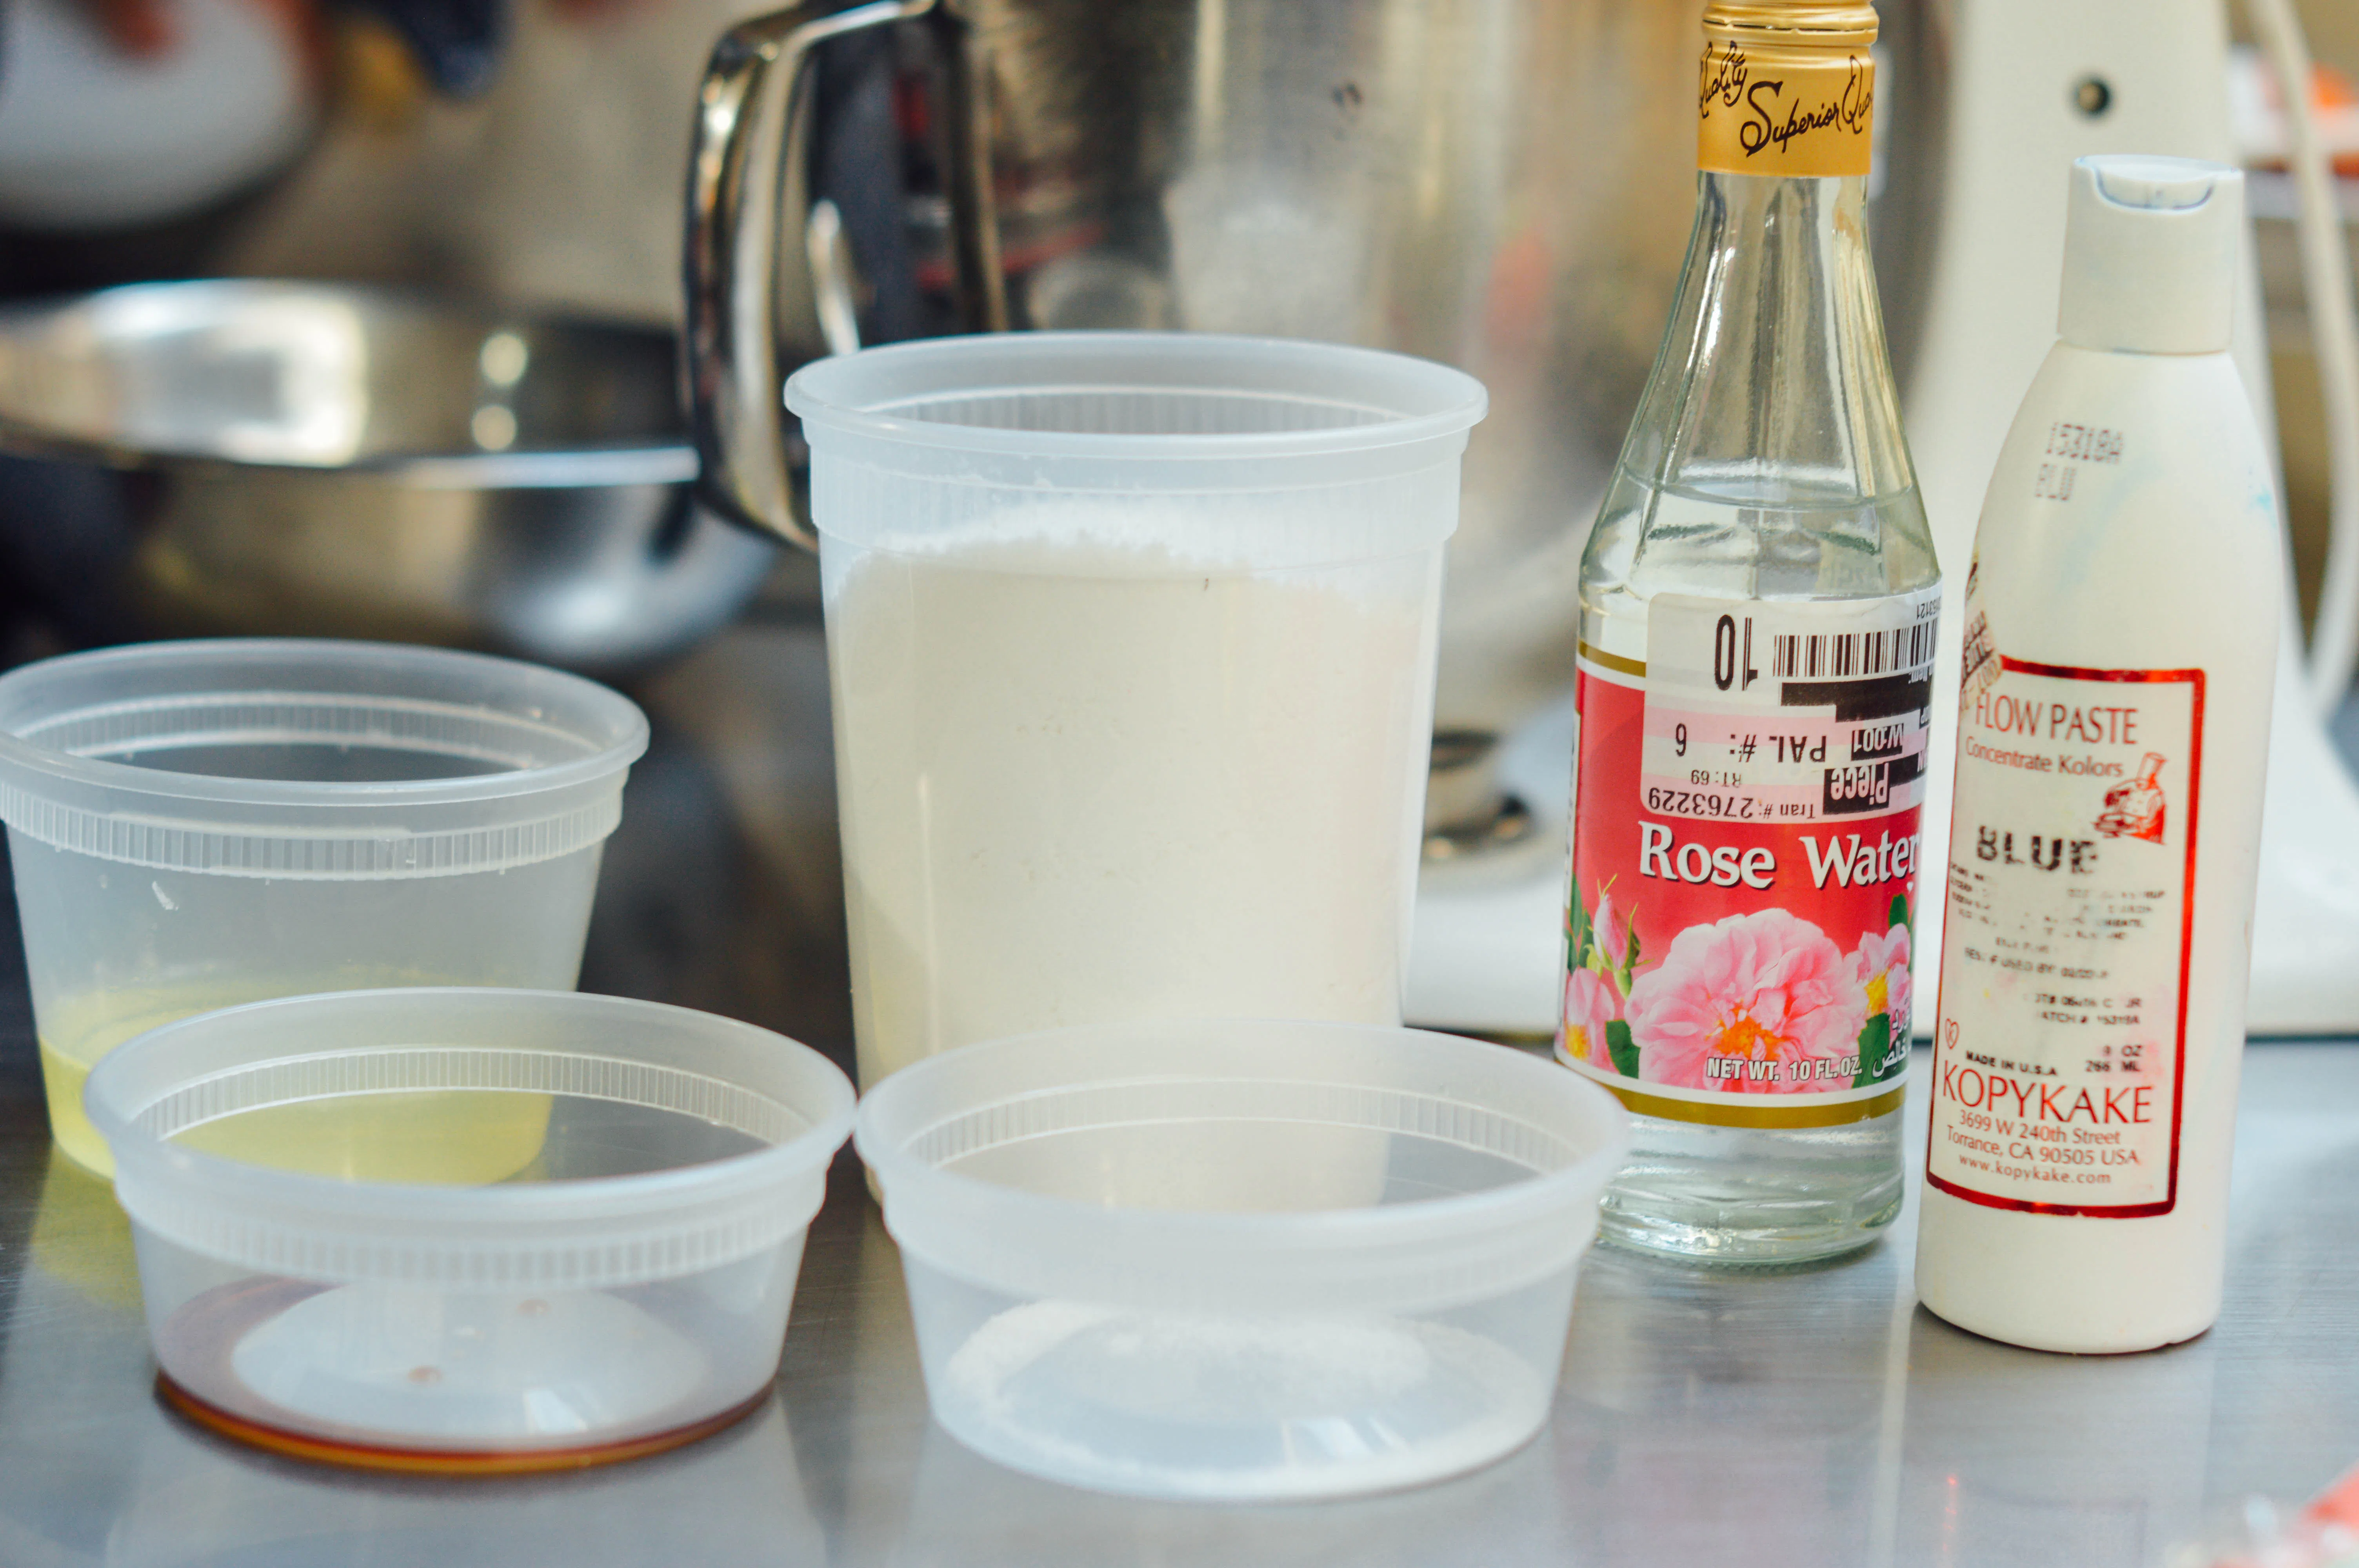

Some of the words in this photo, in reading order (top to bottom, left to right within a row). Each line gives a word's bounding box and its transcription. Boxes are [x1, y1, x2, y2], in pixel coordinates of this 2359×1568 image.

[1740, 80, 1841, 157] Superior
[1714, 614, 1758, 691] 10
[1976, 692, 2043, 737] FLOW
[2050, 704, 2138, 745] PASTE
[1675, 723, 1687, 757] 6
[1769, 735, 1826, 763] PAL
[1965, 735, 2052, 773] Concentrate
[2058, 754, 2124, 777] Kolors
[1691, 769, 1710, 784] 69
[1830, 761, 1890, 806] Piece
[1648, 787, 1754, 818] 2763229
[1781, 803, 1816, 819] Tran
[1638, 820, 1777, 889] Rose
[1798, 829, 1920, 888] Water
[1977, 825, 2099, 874] BLUE
[1965, 1050, 1996, 1068] MADE
[2001, 1060, 2015, 1071] IN
[2122, 1045, 2143, 1057] OZ
[2122, 1060, 2141, 1073] ML
[1707, 1057, 1744, 1080] NET
[1748, 1060, 1780, 1081] WT.
[1789, 1060, 1811, 1080] 10
[1943, 1059, 2154, 1124] KOPYKAKE
[1959, 1109, 1992, 1132] 3699
[1996, 1118, 2014, 1136] W
[2019, 1123, 2067, 1143] 240th
[2072, 1127, 2121, 1144] Street
[1947, 1124, 2003, 1157] Torrance,
[2008, 1142, 2034, 1160] CA
[2039, 1146, 2095, 1165] 90505
[2101, 1149, 2141, 1166] USA
[1959, 1153, 2112, 1184] www.kopykake.com
